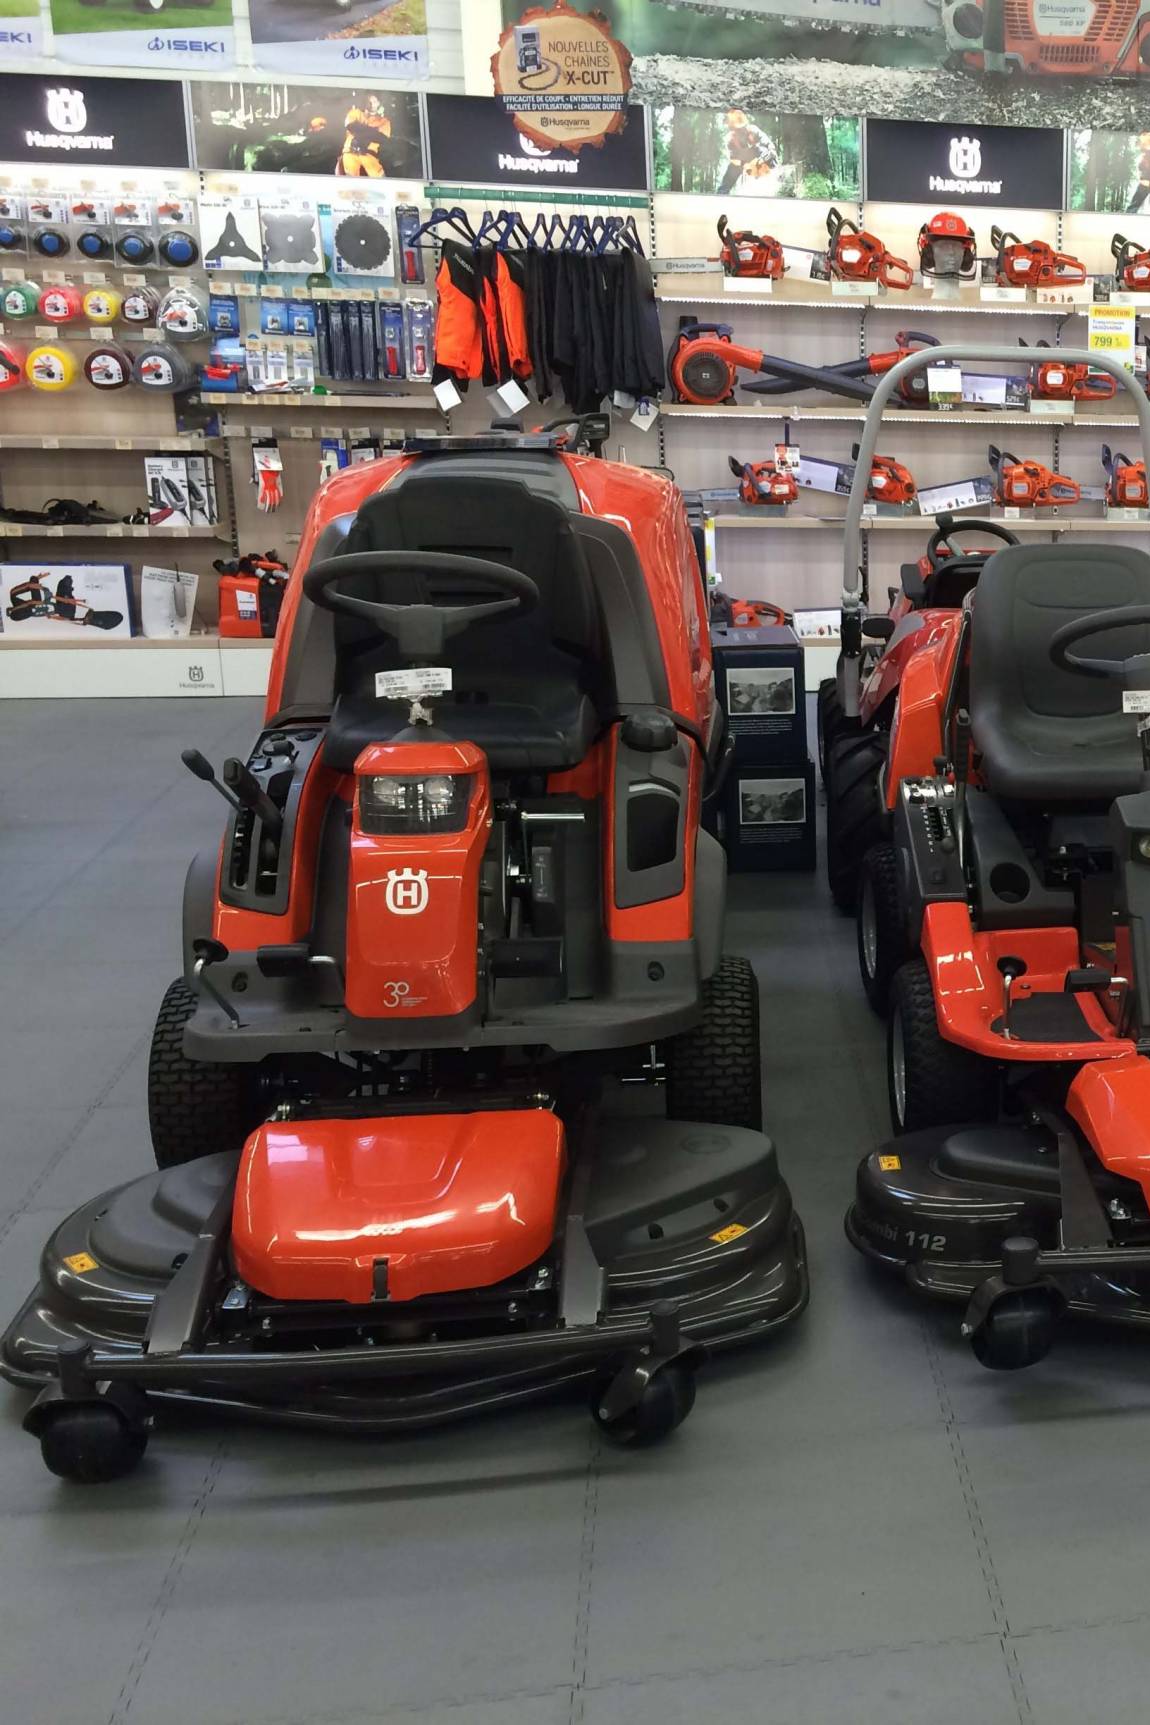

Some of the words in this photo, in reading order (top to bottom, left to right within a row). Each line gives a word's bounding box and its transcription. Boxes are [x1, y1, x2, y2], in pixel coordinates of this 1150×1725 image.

[1047, 4, 1085, 14] Husqvarna
[167, 39, 225, 53] ISEKI
[548, 41, 609, 54] NOUVELLES
[362, 48, 418, 61] ISEKI
[564, 55, 610, 68] CHAÎNES
[503, 95, 535, 103] EFFICACITÉ
[602, 94, 624, 103] RÉDUIT
[506, 102, 531, 110] FACILITÉ
[577, 103, 601, 111] LONGUE
[602, 102, 622, 111] DURÉE
[549, 117, 590, 127] Husqvarna
[24, 130, 114, 151] Husqvarna
[498, 153, 579, 174] Husqvarna
[929, 175, 1003, 195] Husqvarna
[672, 262, 705, 270] Husqvarna
[1094, 308, 1131, 317] PROMOTION
[1094, 335, 1113, 347] 799
[905, 1230, 947, 1252] 112
